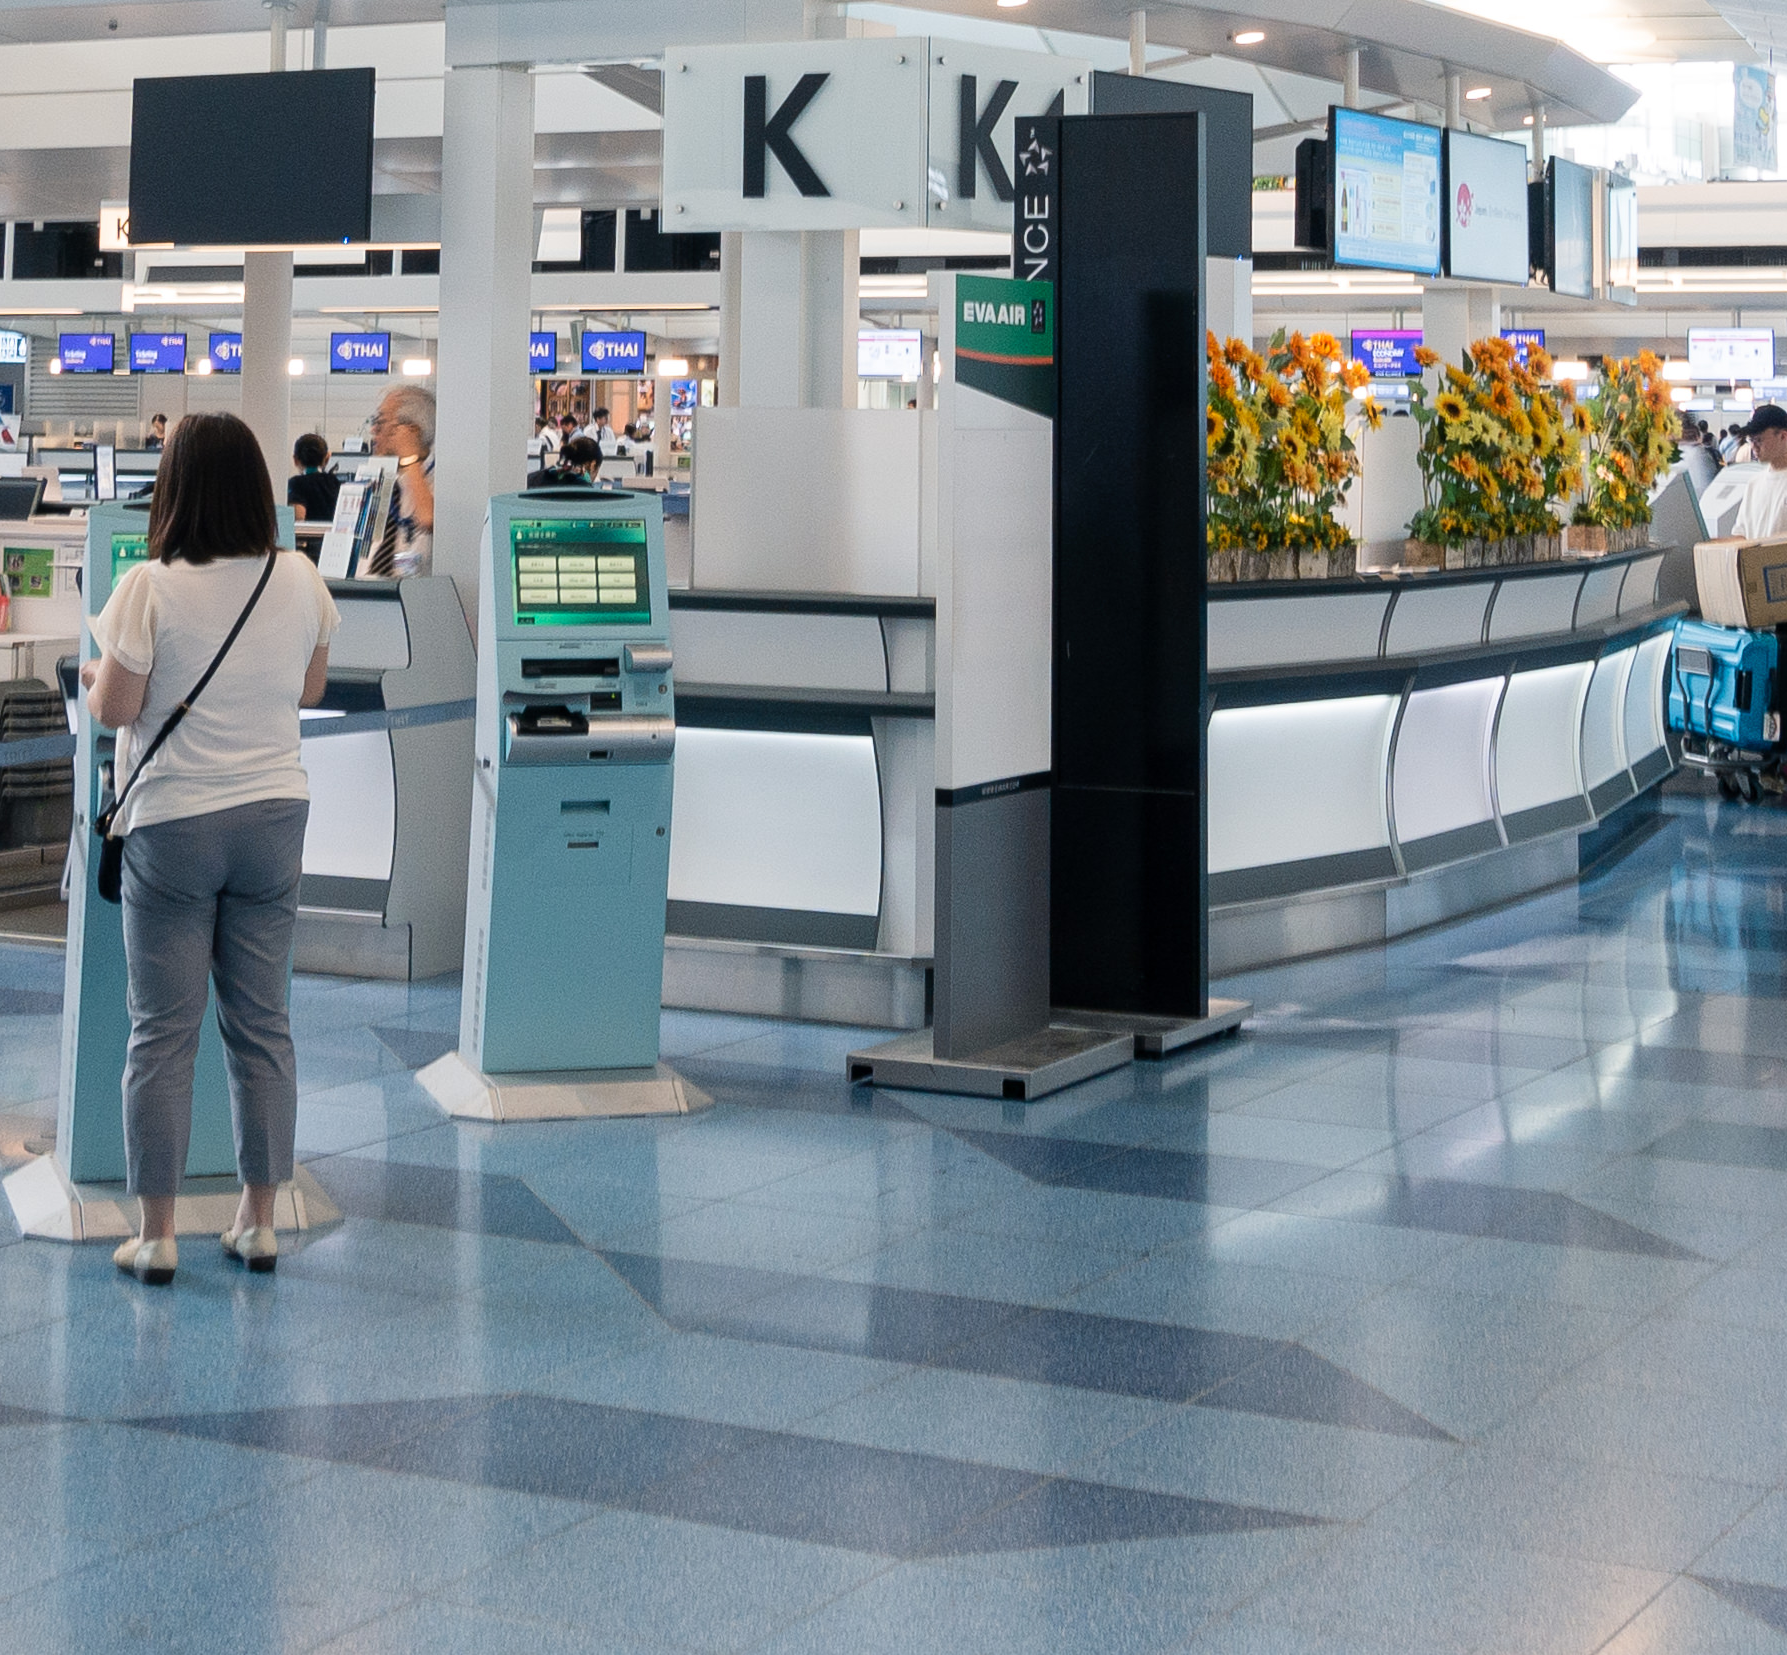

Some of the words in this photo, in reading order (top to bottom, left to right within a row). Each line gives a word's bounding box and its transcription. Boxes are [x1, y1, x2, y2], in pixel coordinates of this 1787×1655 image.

[742, 73, 831, 198] K
[959, 74, 1019, 202] K
[230, 344, 242, 357] TH
[353, 344, 382, 358] THAI
[530, 342, 549, 357] HAI
[606, 342, 638, 357] THAI
[1372, 339, 1394, 349] THAI
